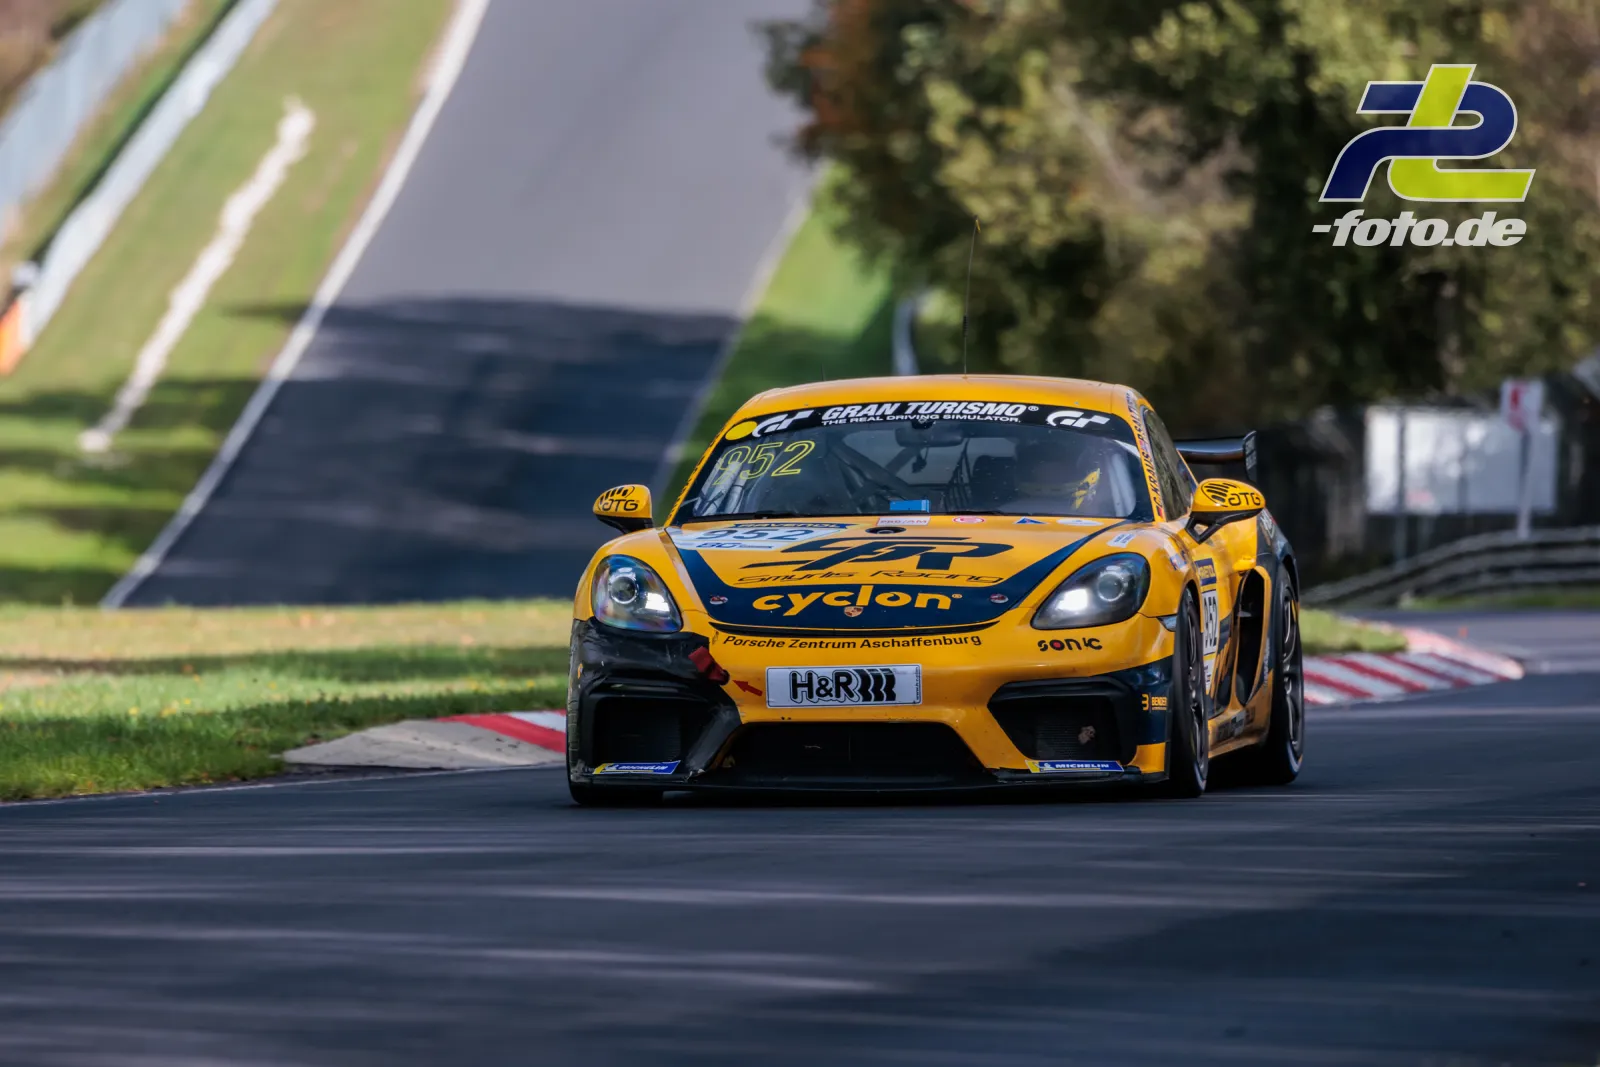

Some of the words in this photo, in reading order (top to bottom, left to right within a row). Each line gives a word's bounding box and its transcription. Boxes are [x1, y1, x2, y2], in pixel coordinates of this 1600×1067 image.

[821, 402, 902, 420] GRAN
[821, 418, 847, 426] THE
[849, 415, 884, 423] REAL
[712, 440, 816, 486] 952
[696, 528, 815, 541] 952
[871, 570, 1004, 584] Racing
[723, 635, 786, 648] Porsche
[788, 639, 857, 649] Zentrum
[859, 635, 982, 649] Aschaffenburg
[1037, 637, 1103, 652] sonic
[789, 670, 861, 704] H&R
